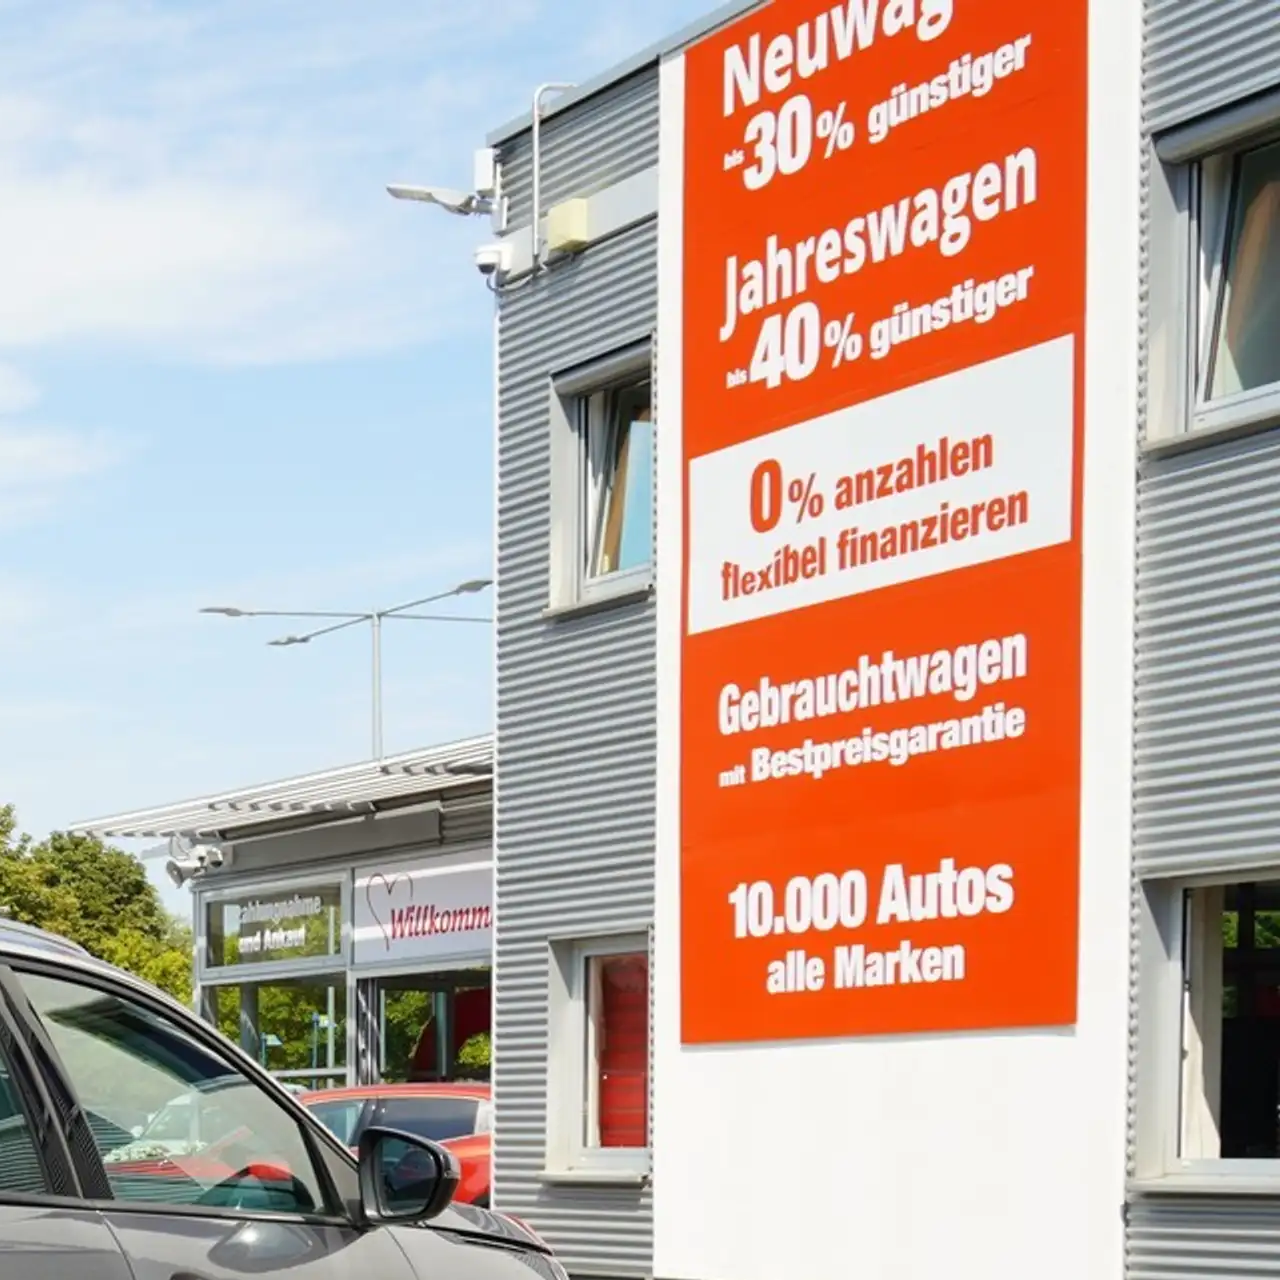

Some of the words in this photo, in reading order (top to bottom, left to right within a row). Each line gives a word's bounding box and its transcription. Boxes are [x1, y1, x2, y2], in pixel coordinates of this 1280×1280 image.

[868, 34, 1033, 144] günstiger
[719, 145, 1037, 342] Jahreswagen
[870, 264, 1035, 360] günstiger
[834, 433, 993, 512] anzahlen
[721, 537, 827, 601] flexibel
[836, 489, 1029, 572] finanzieren
[719, 632, 1028, 736] Gebrauchtwagen
[719, 764, 745, 788] mit
[751, 702, 1026, 783] Bestpreisgarantie
[391, 904, 494, 939] Willkomm
[728, 869, 866, 938] 10.000
[876, 857, 1015, 925] Autos
[767, 950, 824, 995] alle
[834, 939, 965, 989] Marken
